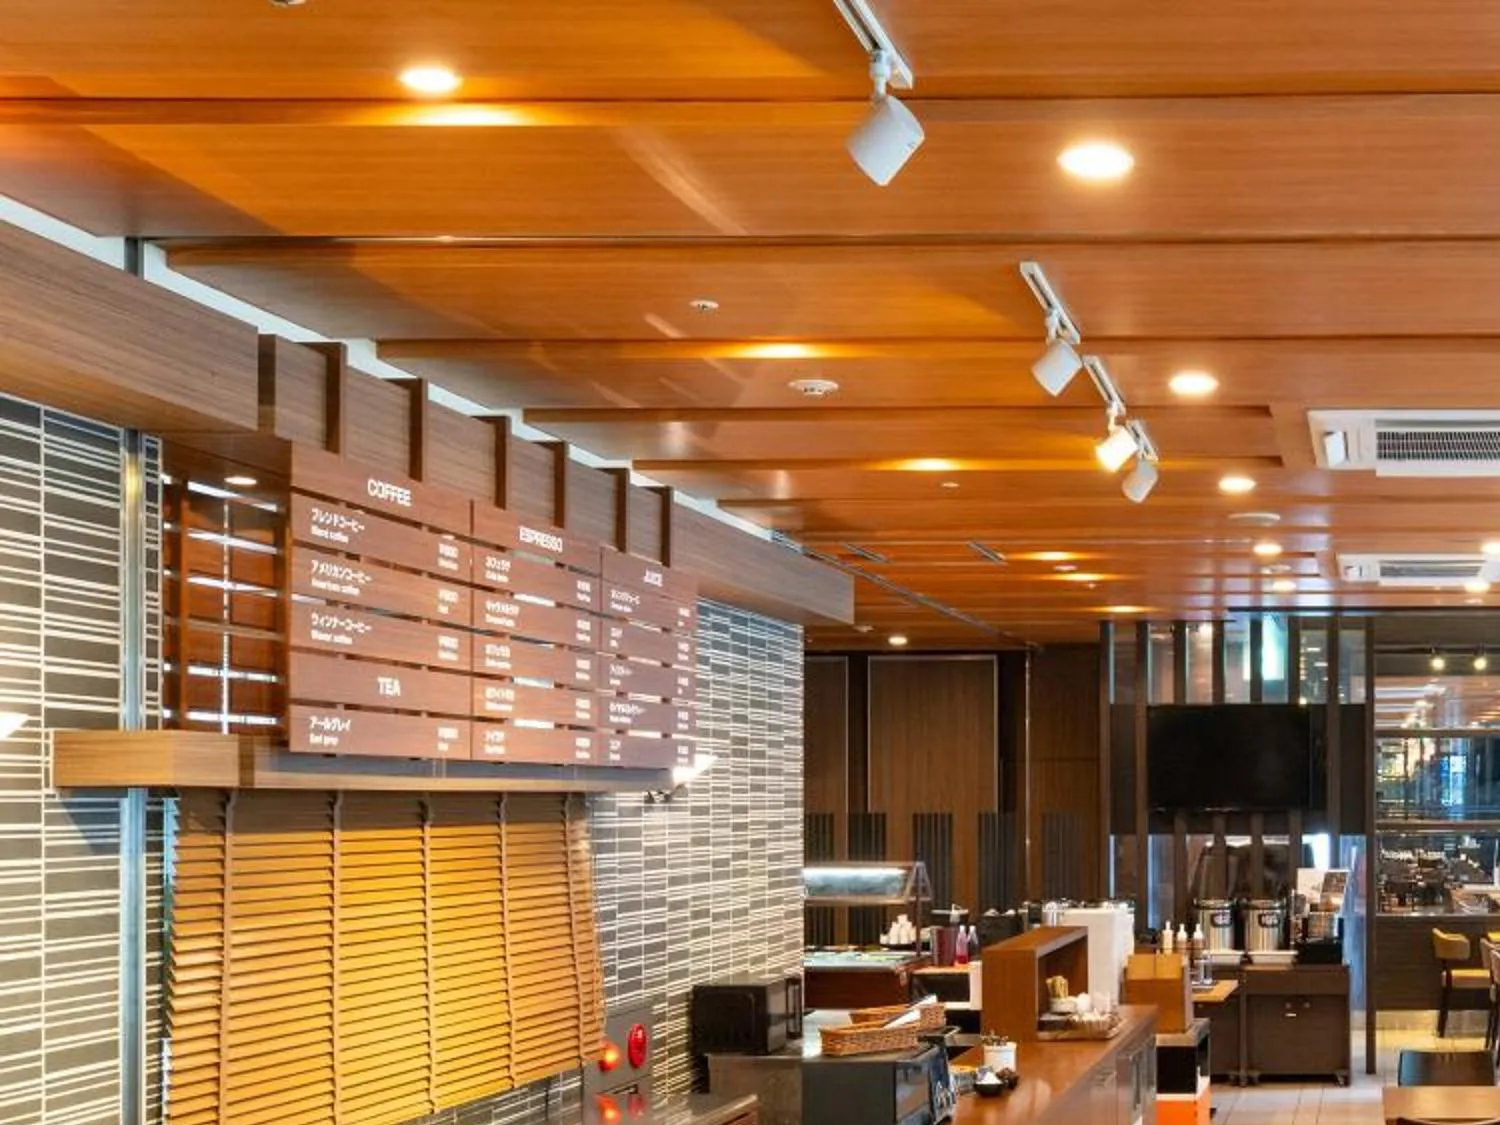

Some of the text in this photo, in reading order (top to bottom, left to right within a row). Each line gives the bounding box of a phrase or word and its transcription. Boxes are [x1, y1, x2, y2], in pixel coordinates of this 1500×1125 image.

[368, 479, 412, 507] COFFEE
[519, 525, 563, 553] ESPRESSO
[378, 677, 400, 696] TEA
